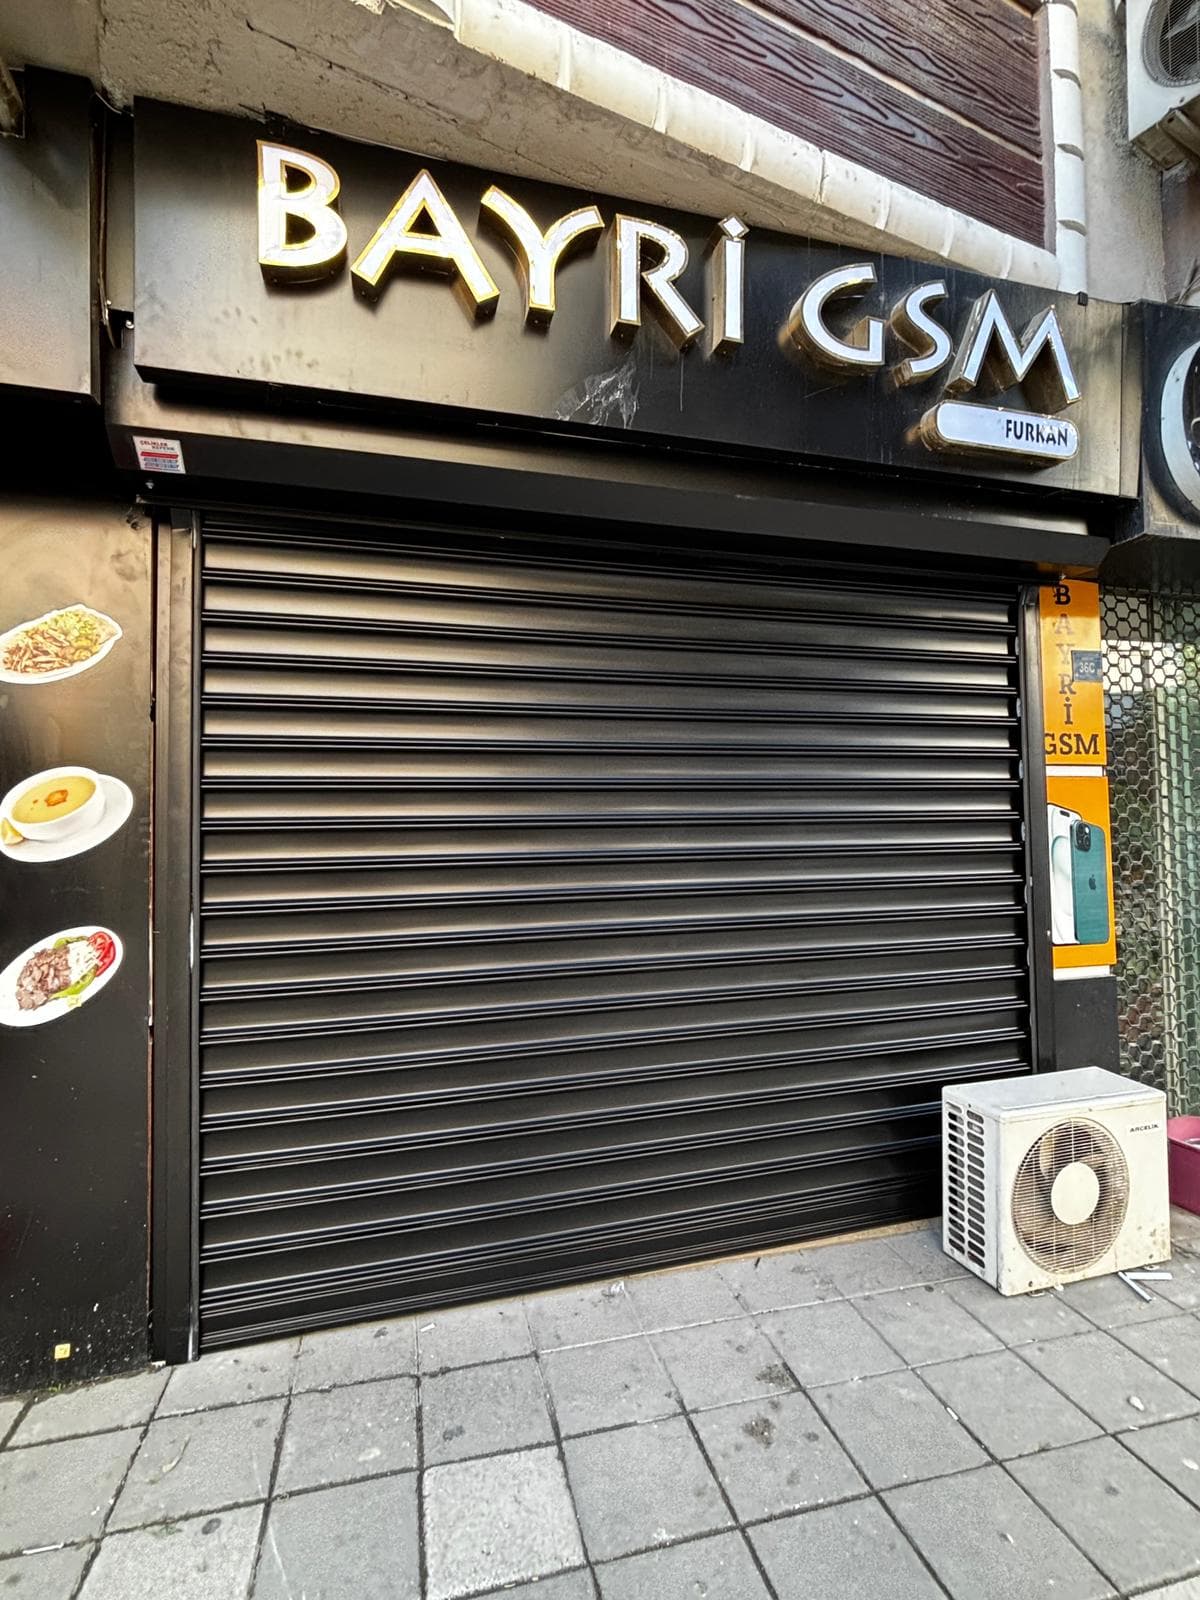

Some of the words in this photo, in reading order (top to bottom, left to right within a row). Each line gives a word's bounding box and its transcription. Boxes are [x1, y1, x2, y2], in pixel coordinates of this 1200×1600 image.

[797, 261, 1082, 405] GSM
[1006, 419, 1068, 446] FURKAN
[1079, 661, 1096, 674] 36C
[1045, 733, 1100, 755] GSM
